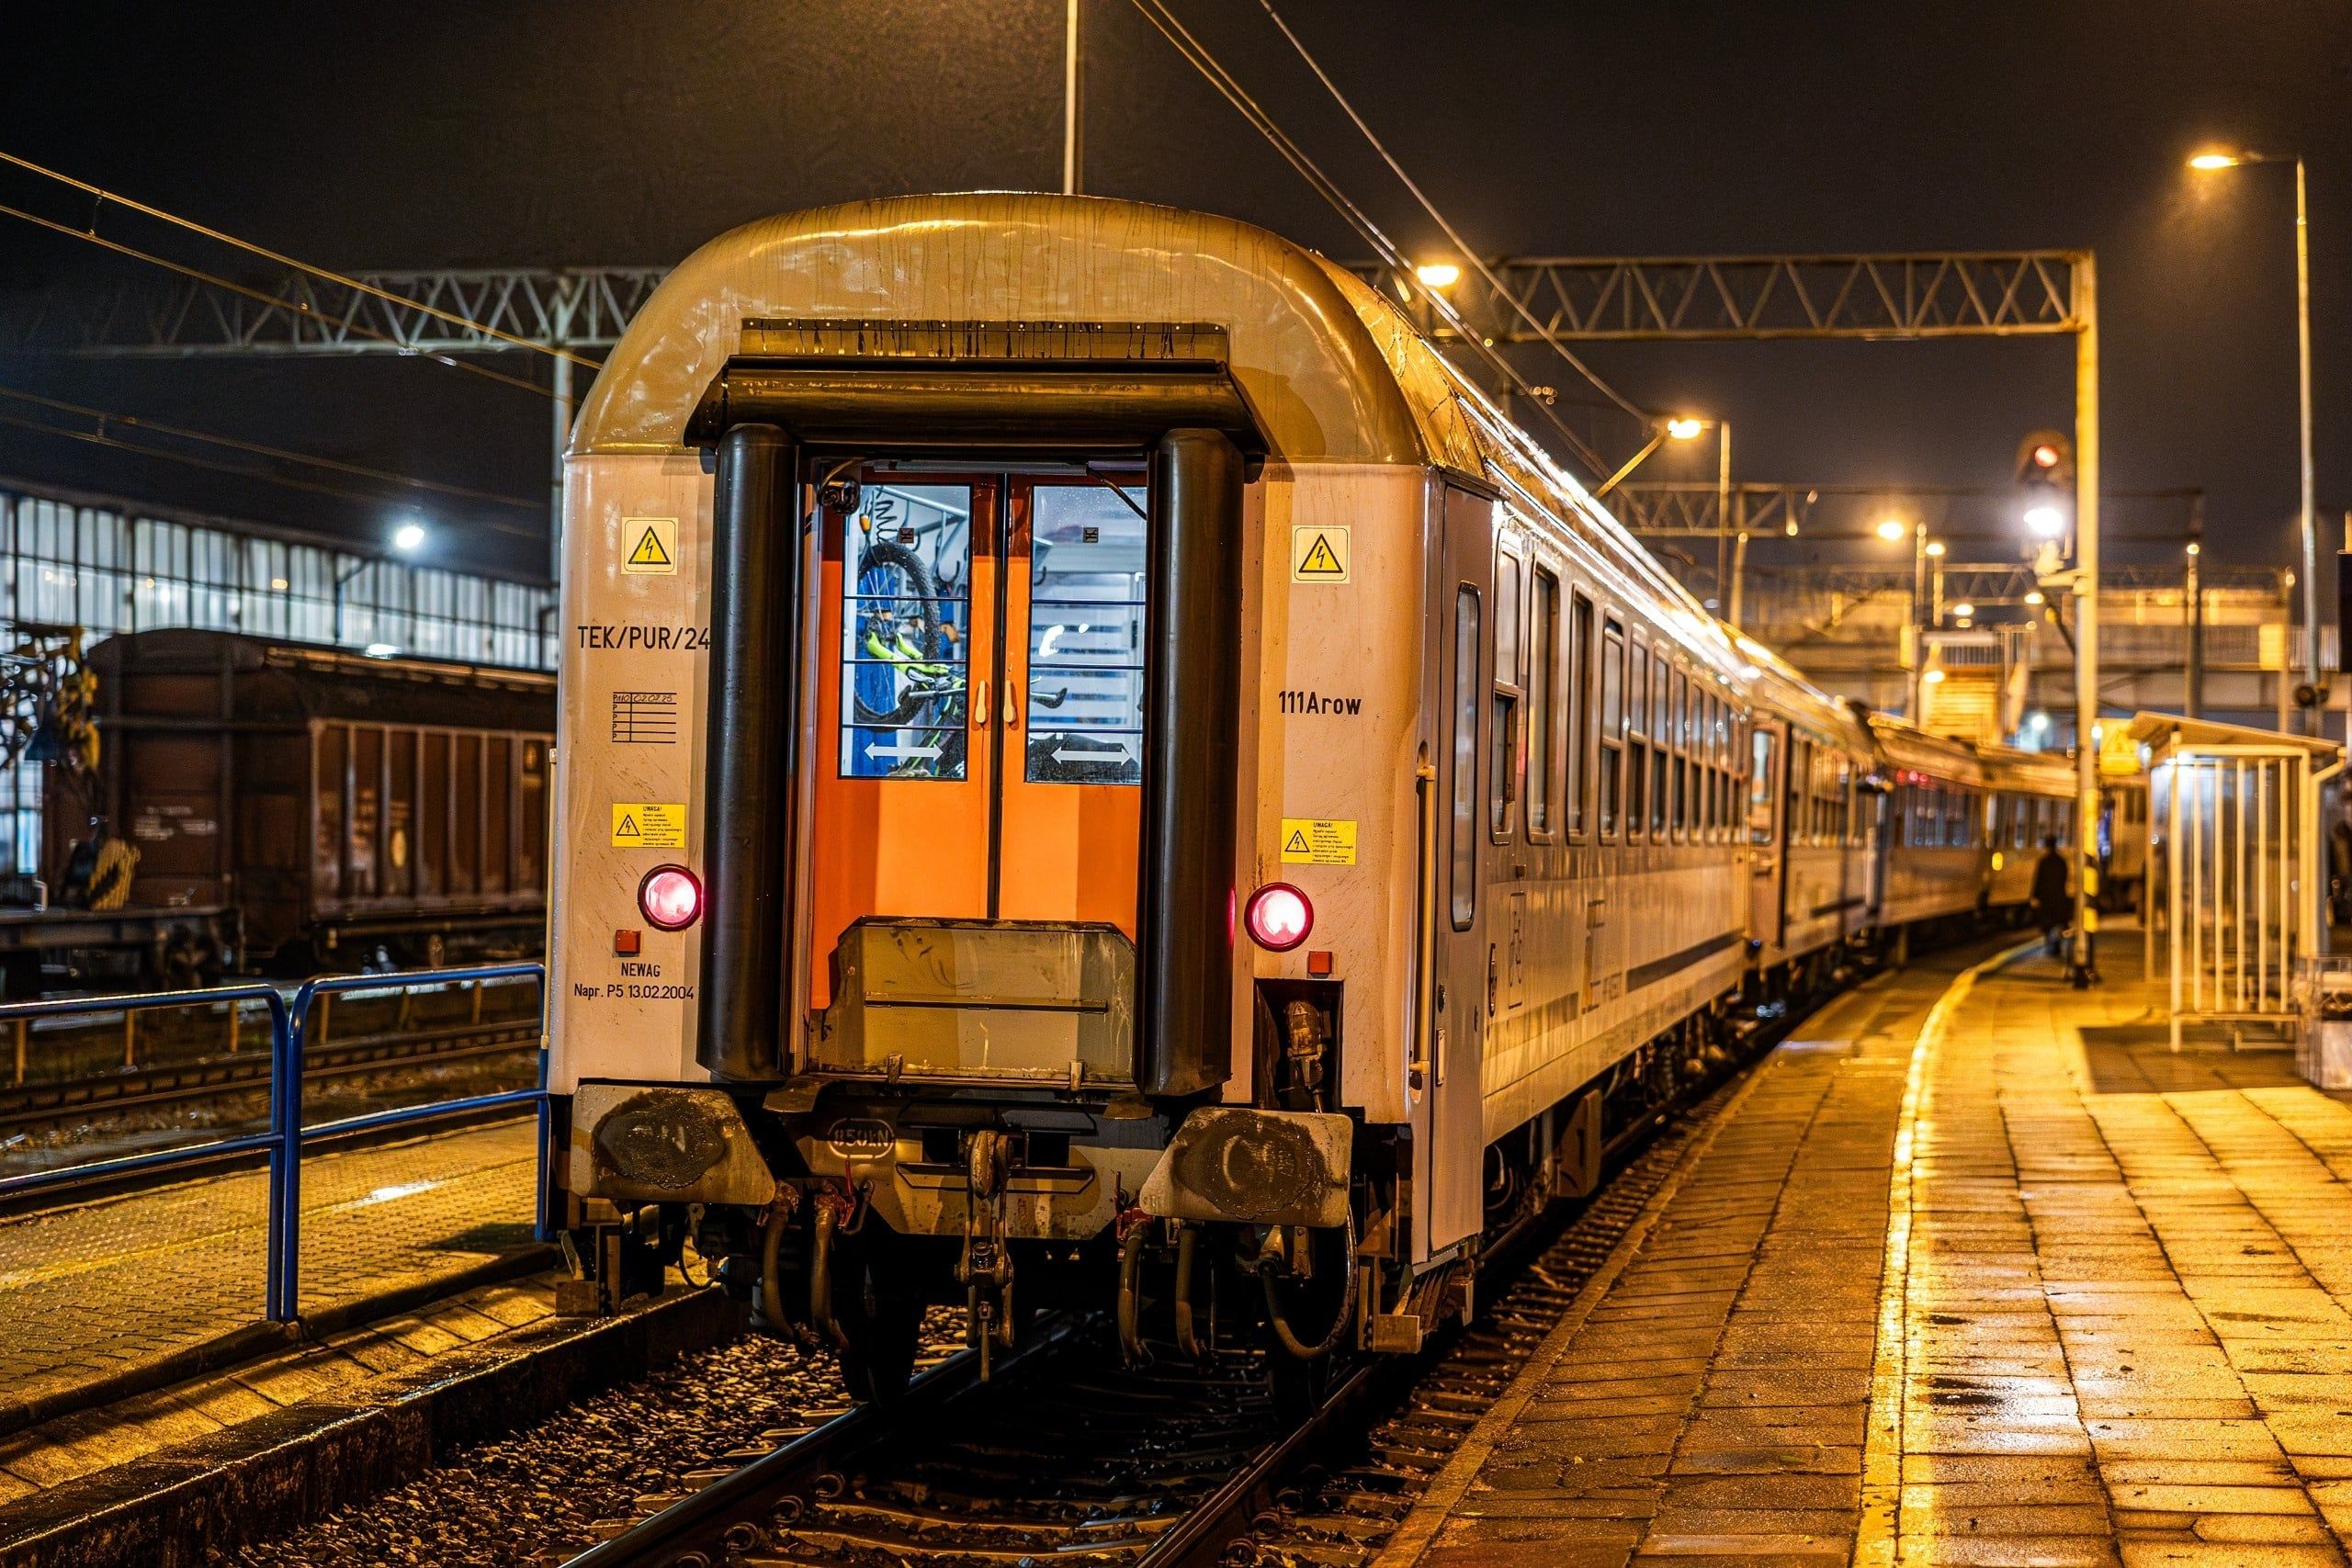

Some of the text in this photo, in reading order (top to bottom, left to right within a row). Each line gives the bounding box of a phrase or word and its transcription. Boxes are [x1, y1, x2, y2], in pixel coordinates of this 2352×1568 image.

[577, 626, 710, 649] TEK/PUR/24
[1278, 691, 1362, 715] 111Arow
[621, 963, 661, 977] NEWAG
[574, 984, 694, 1000] Napr. P5 13.02.2004
